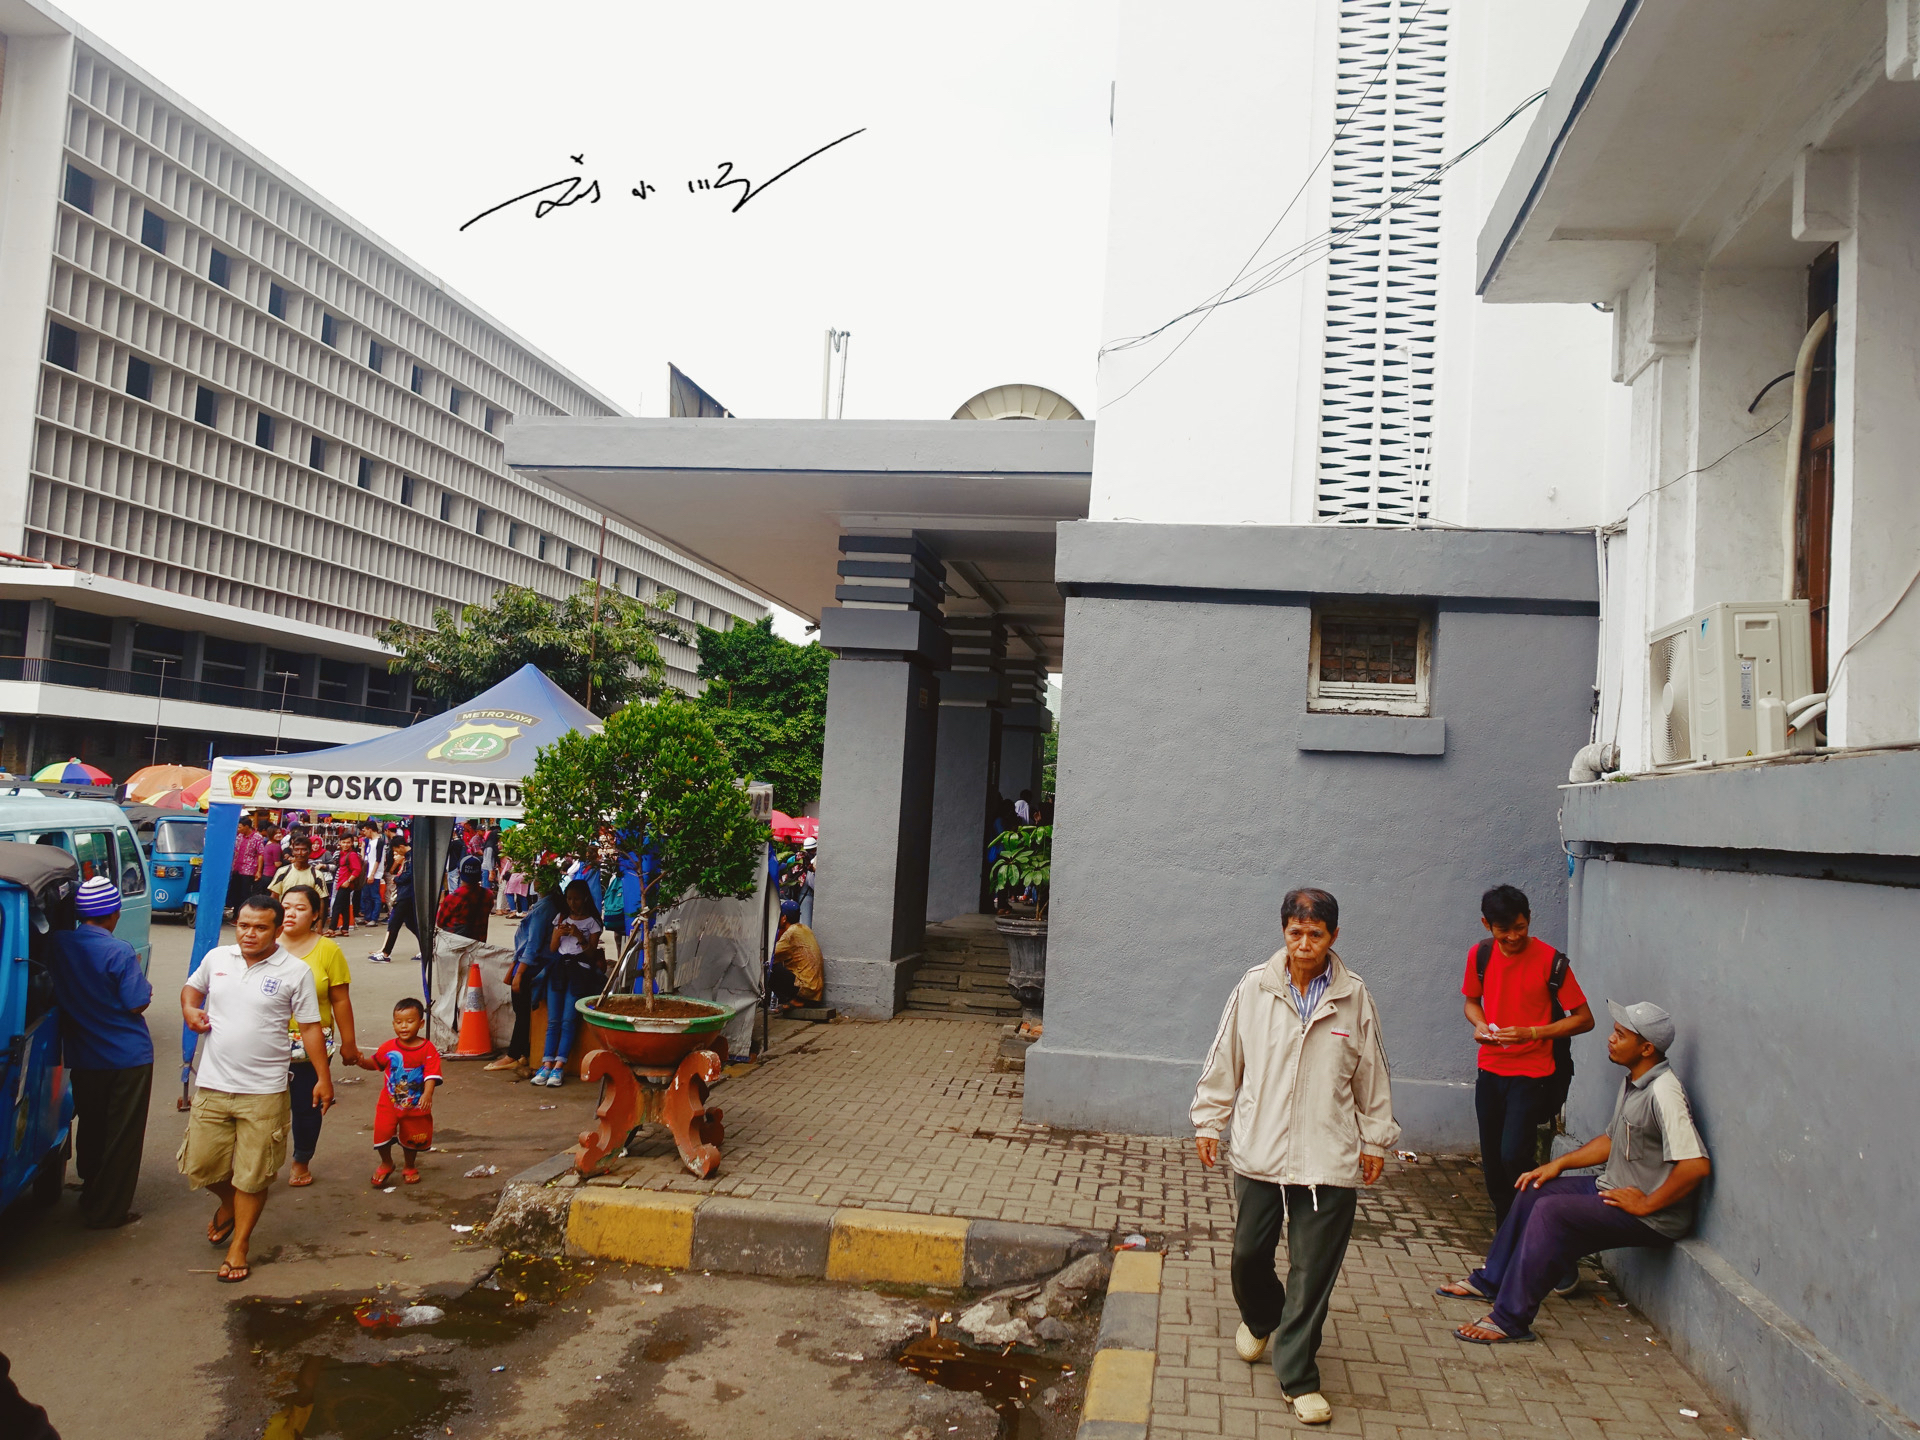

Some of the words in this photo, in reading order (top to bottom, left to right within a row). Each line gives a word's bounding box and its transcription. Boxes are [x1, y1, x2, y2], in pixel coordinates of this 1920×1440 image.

[462, 711, 504, 720] METRO
[506, 713, 533, 724] JAYA
[307, 774, 402, 801] POSKO
[412, 778, 522, 807] TERPAD
